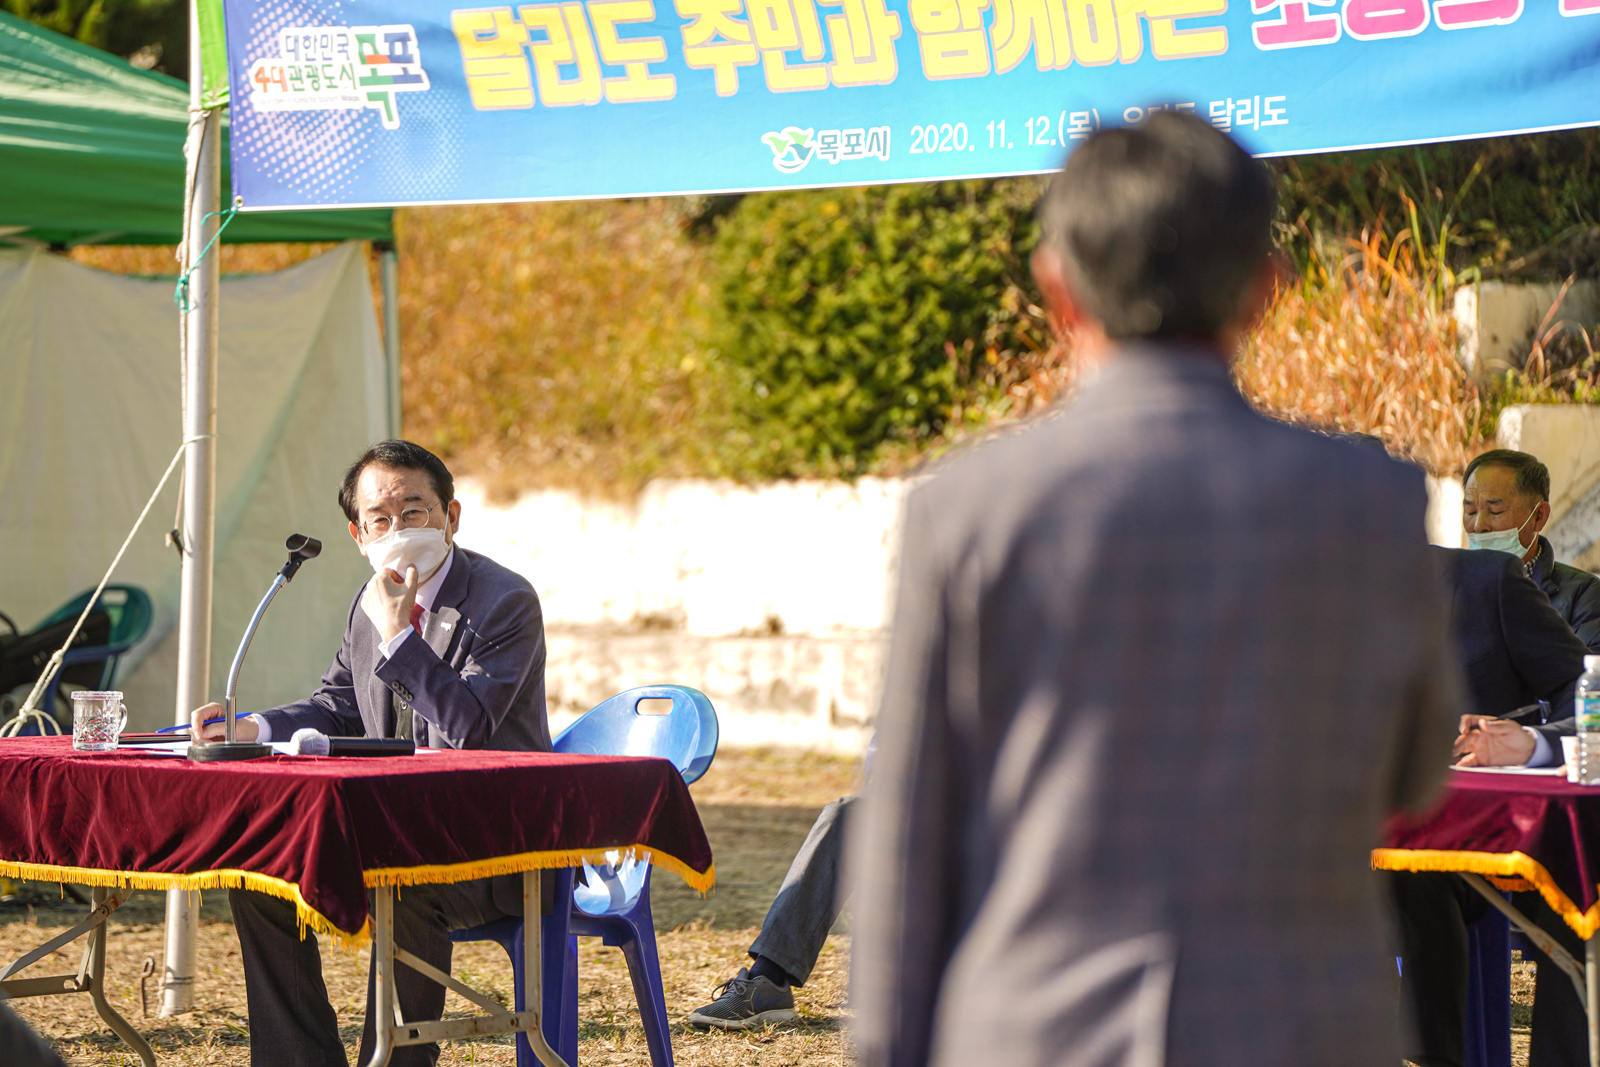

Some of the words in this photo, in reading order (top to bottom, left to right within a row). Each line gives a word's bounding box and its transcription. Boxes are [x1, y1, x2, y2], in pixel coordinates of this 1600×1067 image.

[285, 33, 350, 62] 대한민국
[354, 31, 424, 122] 목포
[451, 0, 677, 111] 달리도
[680, 0, 902, 97] 주민과
[819, 128, 890, 162] 목포시
[909, 122, 976, 154] 2020.
[986, 119, 1014, 149] 11.
[1209, 95, 1289, 132] 달리도
